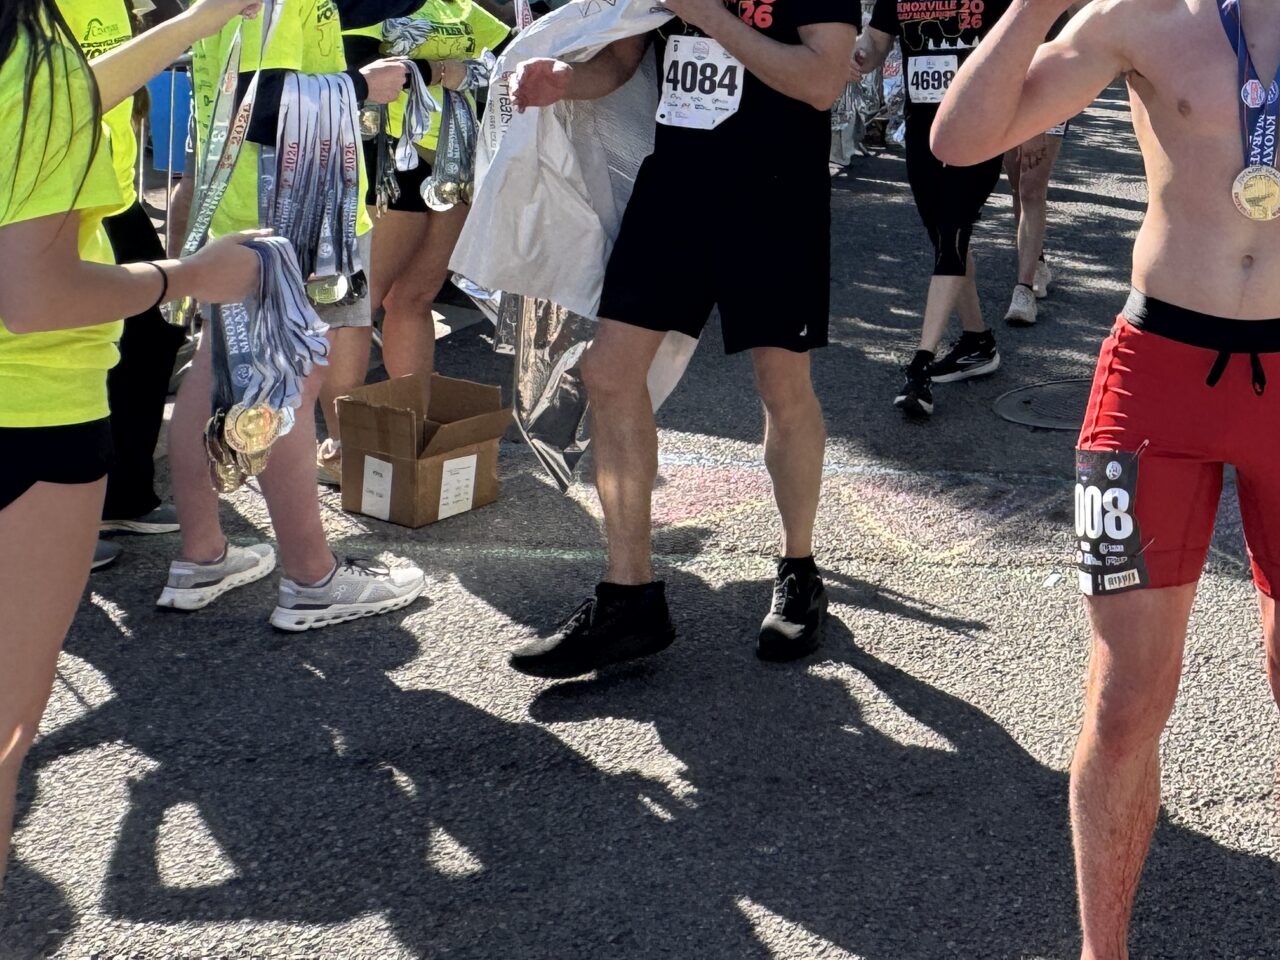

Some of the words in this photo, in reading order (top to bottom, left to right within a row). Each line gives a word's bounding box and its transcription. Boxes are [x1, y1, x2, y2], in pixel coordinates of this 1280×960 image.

[740, 1, 774, 29] 26
[896, 0, 958, 13] KNOXVILLE
[960, 14, 983, 29] 26
[665, 59, 738, 97] 4084
[910, 70, 955, 91] 4698
